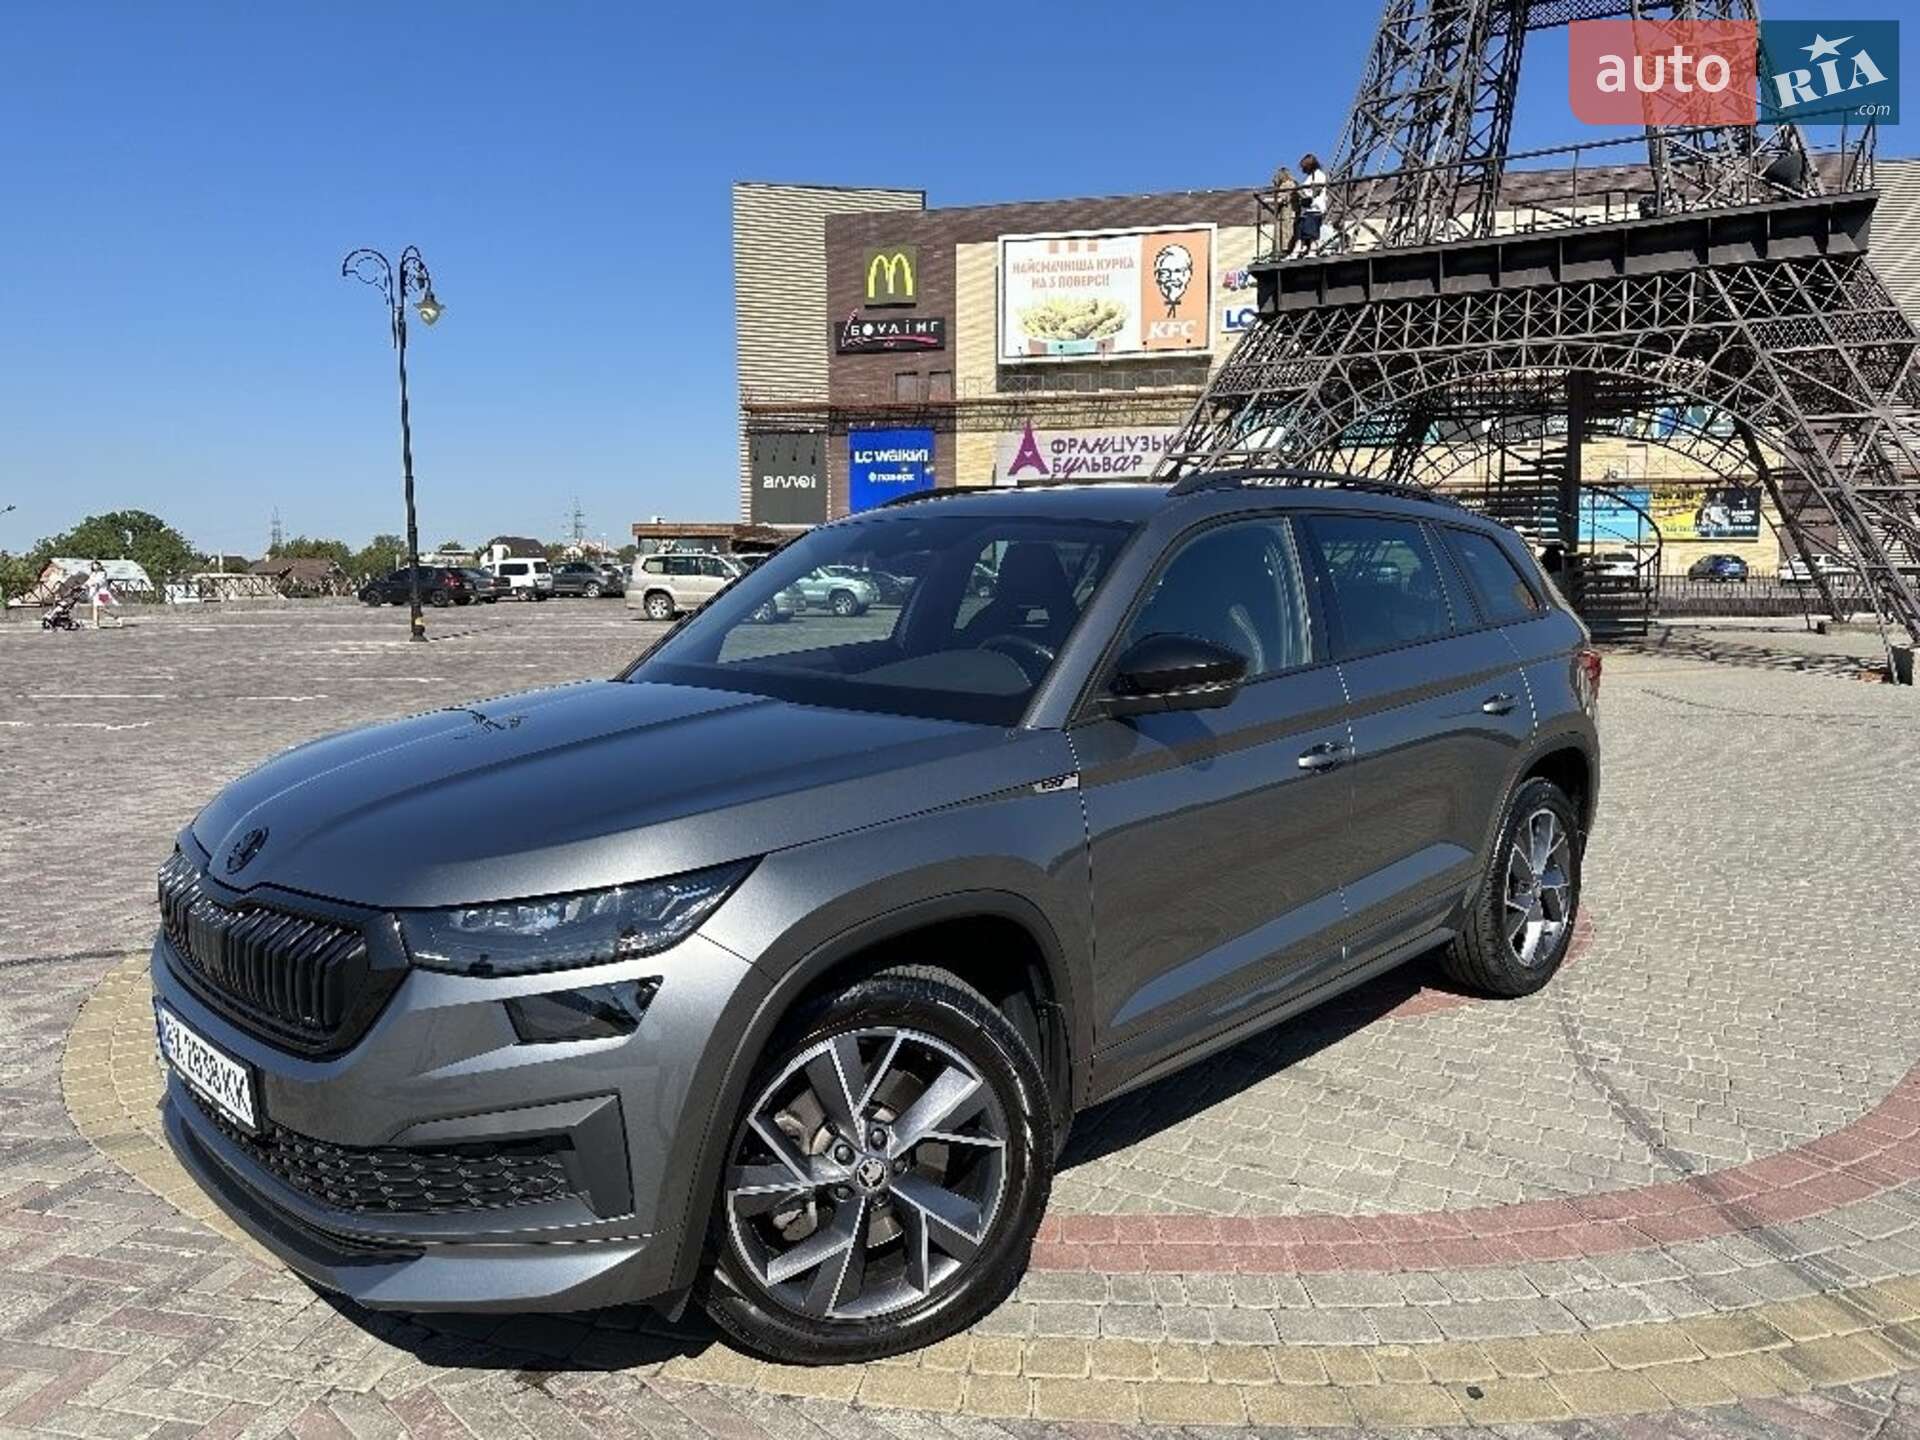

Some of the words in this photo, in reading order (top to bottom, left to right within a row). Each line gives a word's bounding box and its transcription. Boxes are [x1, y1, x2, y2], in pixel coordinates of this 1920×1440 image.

[1096, 256, 1135, 270] КУРКА
[1031, 276, 1047, 289] НА
[1152, 321, 1197, 338] KFC
